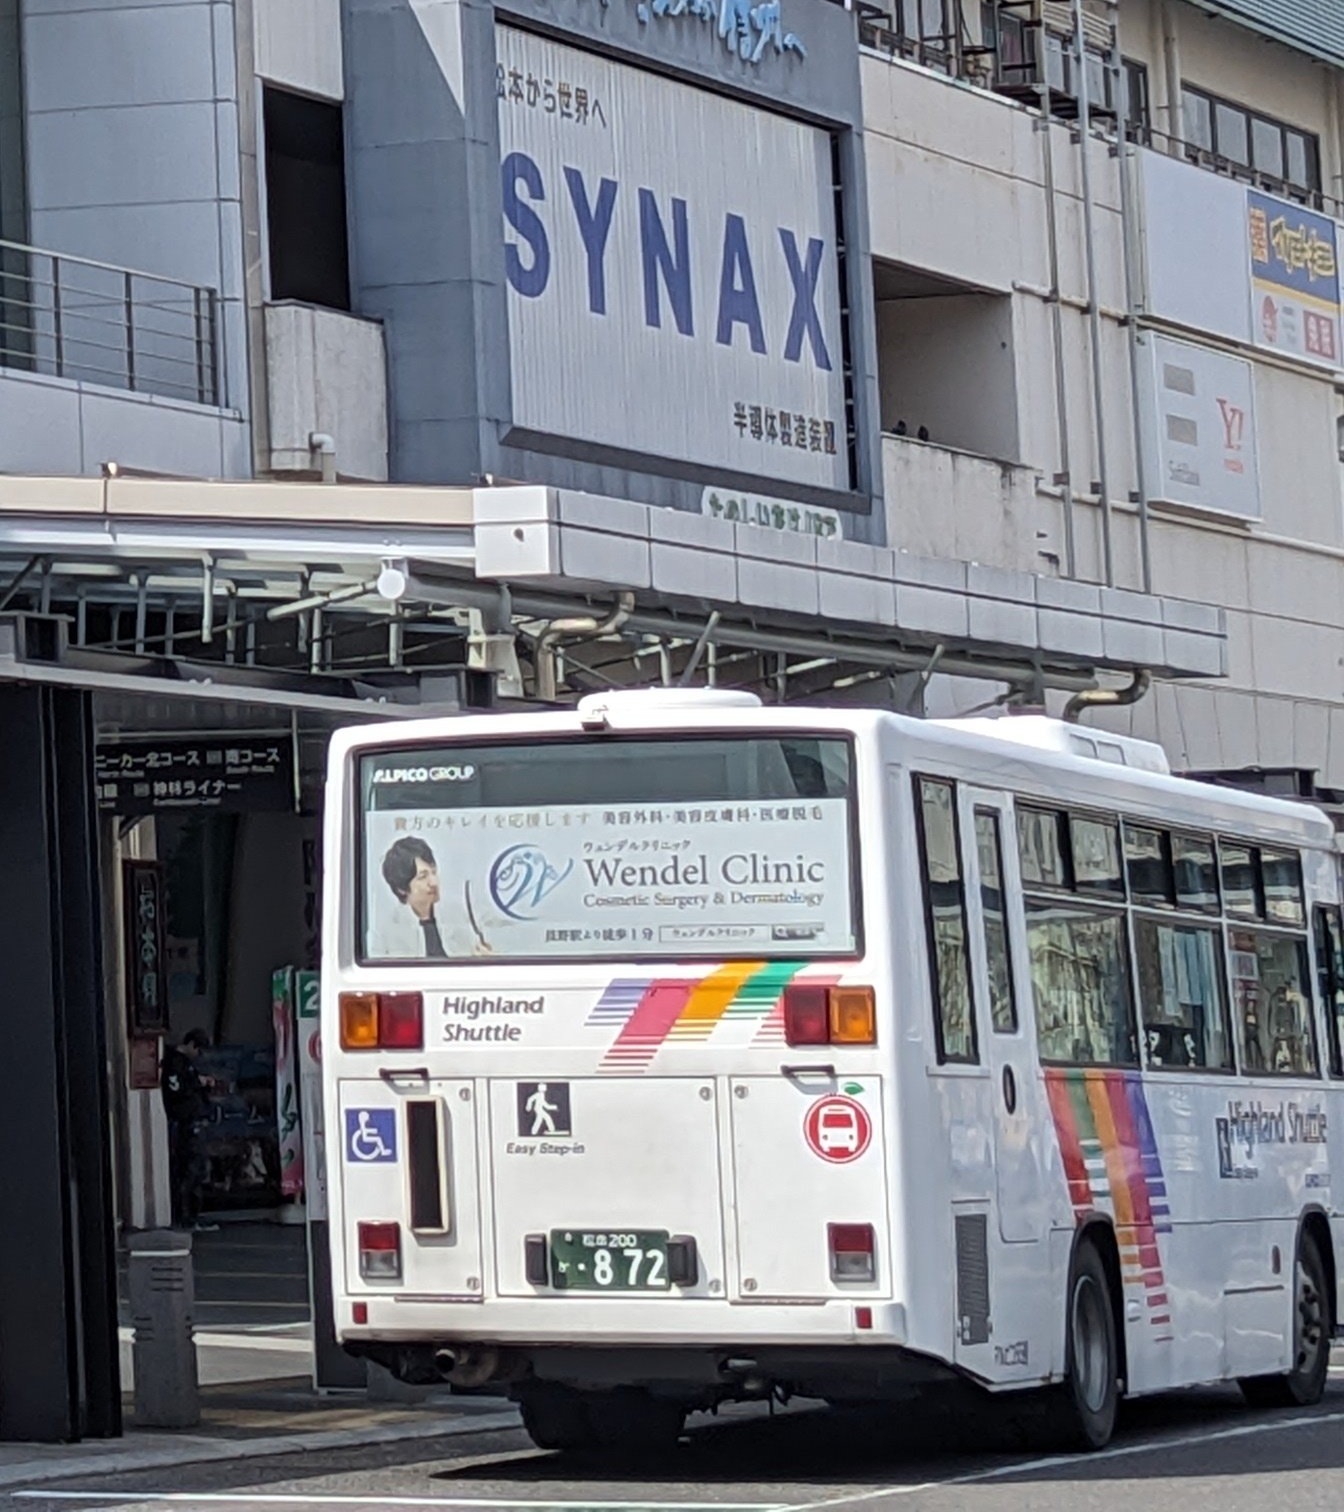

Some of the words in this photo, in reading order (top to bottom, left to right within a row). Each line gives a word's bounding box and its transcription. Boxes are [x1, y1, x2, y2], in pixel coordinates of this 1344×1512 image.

[501, 152, 833, 372] SYNAX
[583, 855, 708, 888] Wendel
[722, 854, 825, 885] Clinic
[583, 892, 649, 908] Cosmetic
[654, 892, 709, 911] Surgery
[713, 891, 726, 906] &
[730, 888, 824, 909] Dermatology
[443, 996, 544, 1019] Highland
[443, 1023, 521, 1042] Shuttle
[506, 1142, 536, 1157] Easy
[539, 1141, 587, 1157] Step-in
